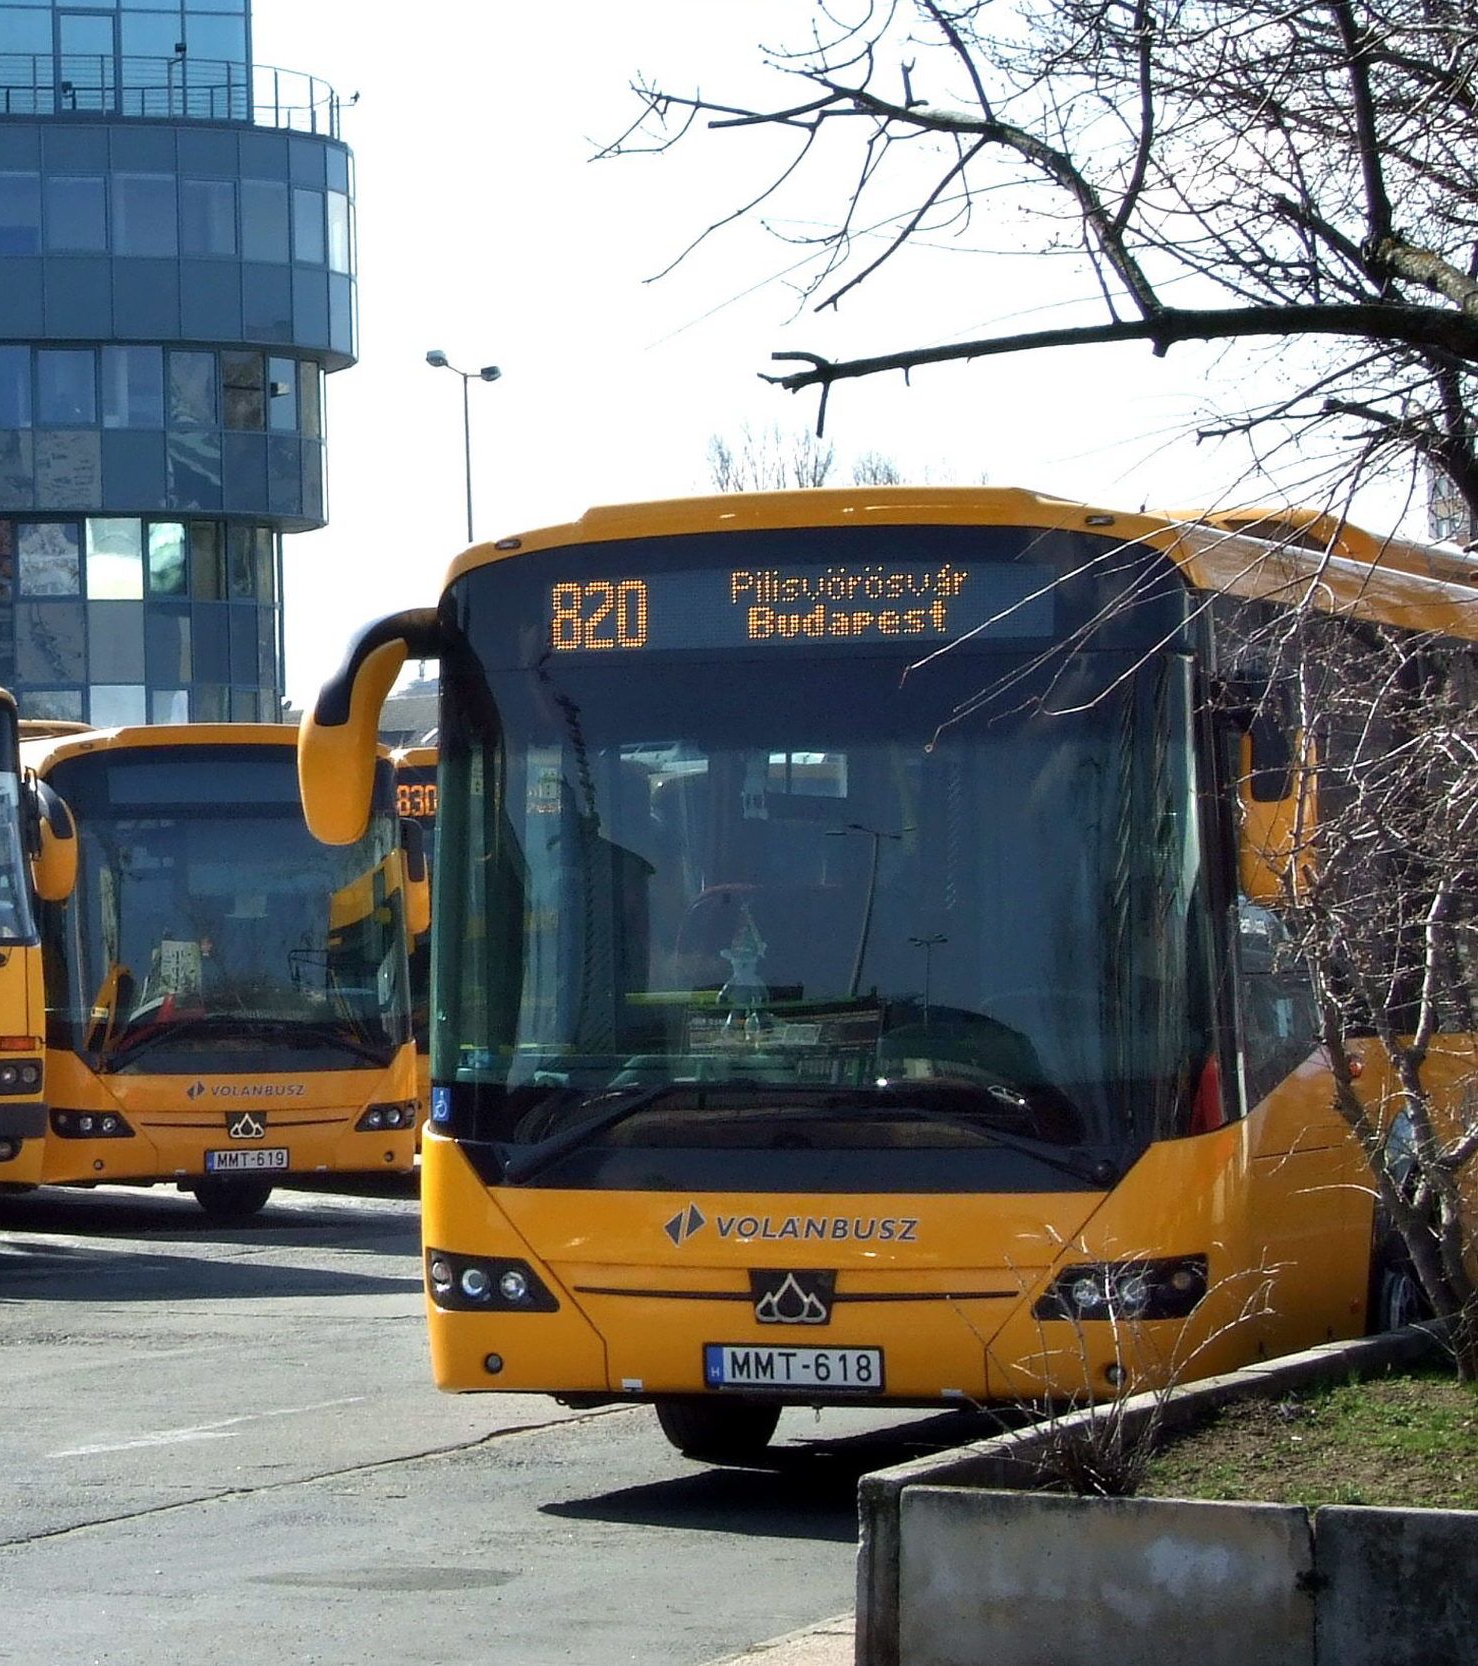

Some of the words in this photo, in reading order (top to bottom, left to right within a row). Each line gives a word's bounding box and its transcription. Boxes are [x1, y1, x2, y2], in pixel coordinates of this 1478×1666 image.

[730, 563, 969, 604] Pilisvörösvár
[551, 580, 648, 650] 820
[747, 600, 948, 639] Budapest
[396, 784, 438, 817] 830
[216, 1151, 284, 1168] MMT-619
[710, 1366, 720, 1377] H
[730, 1351, 873, 1382] MMT-618
